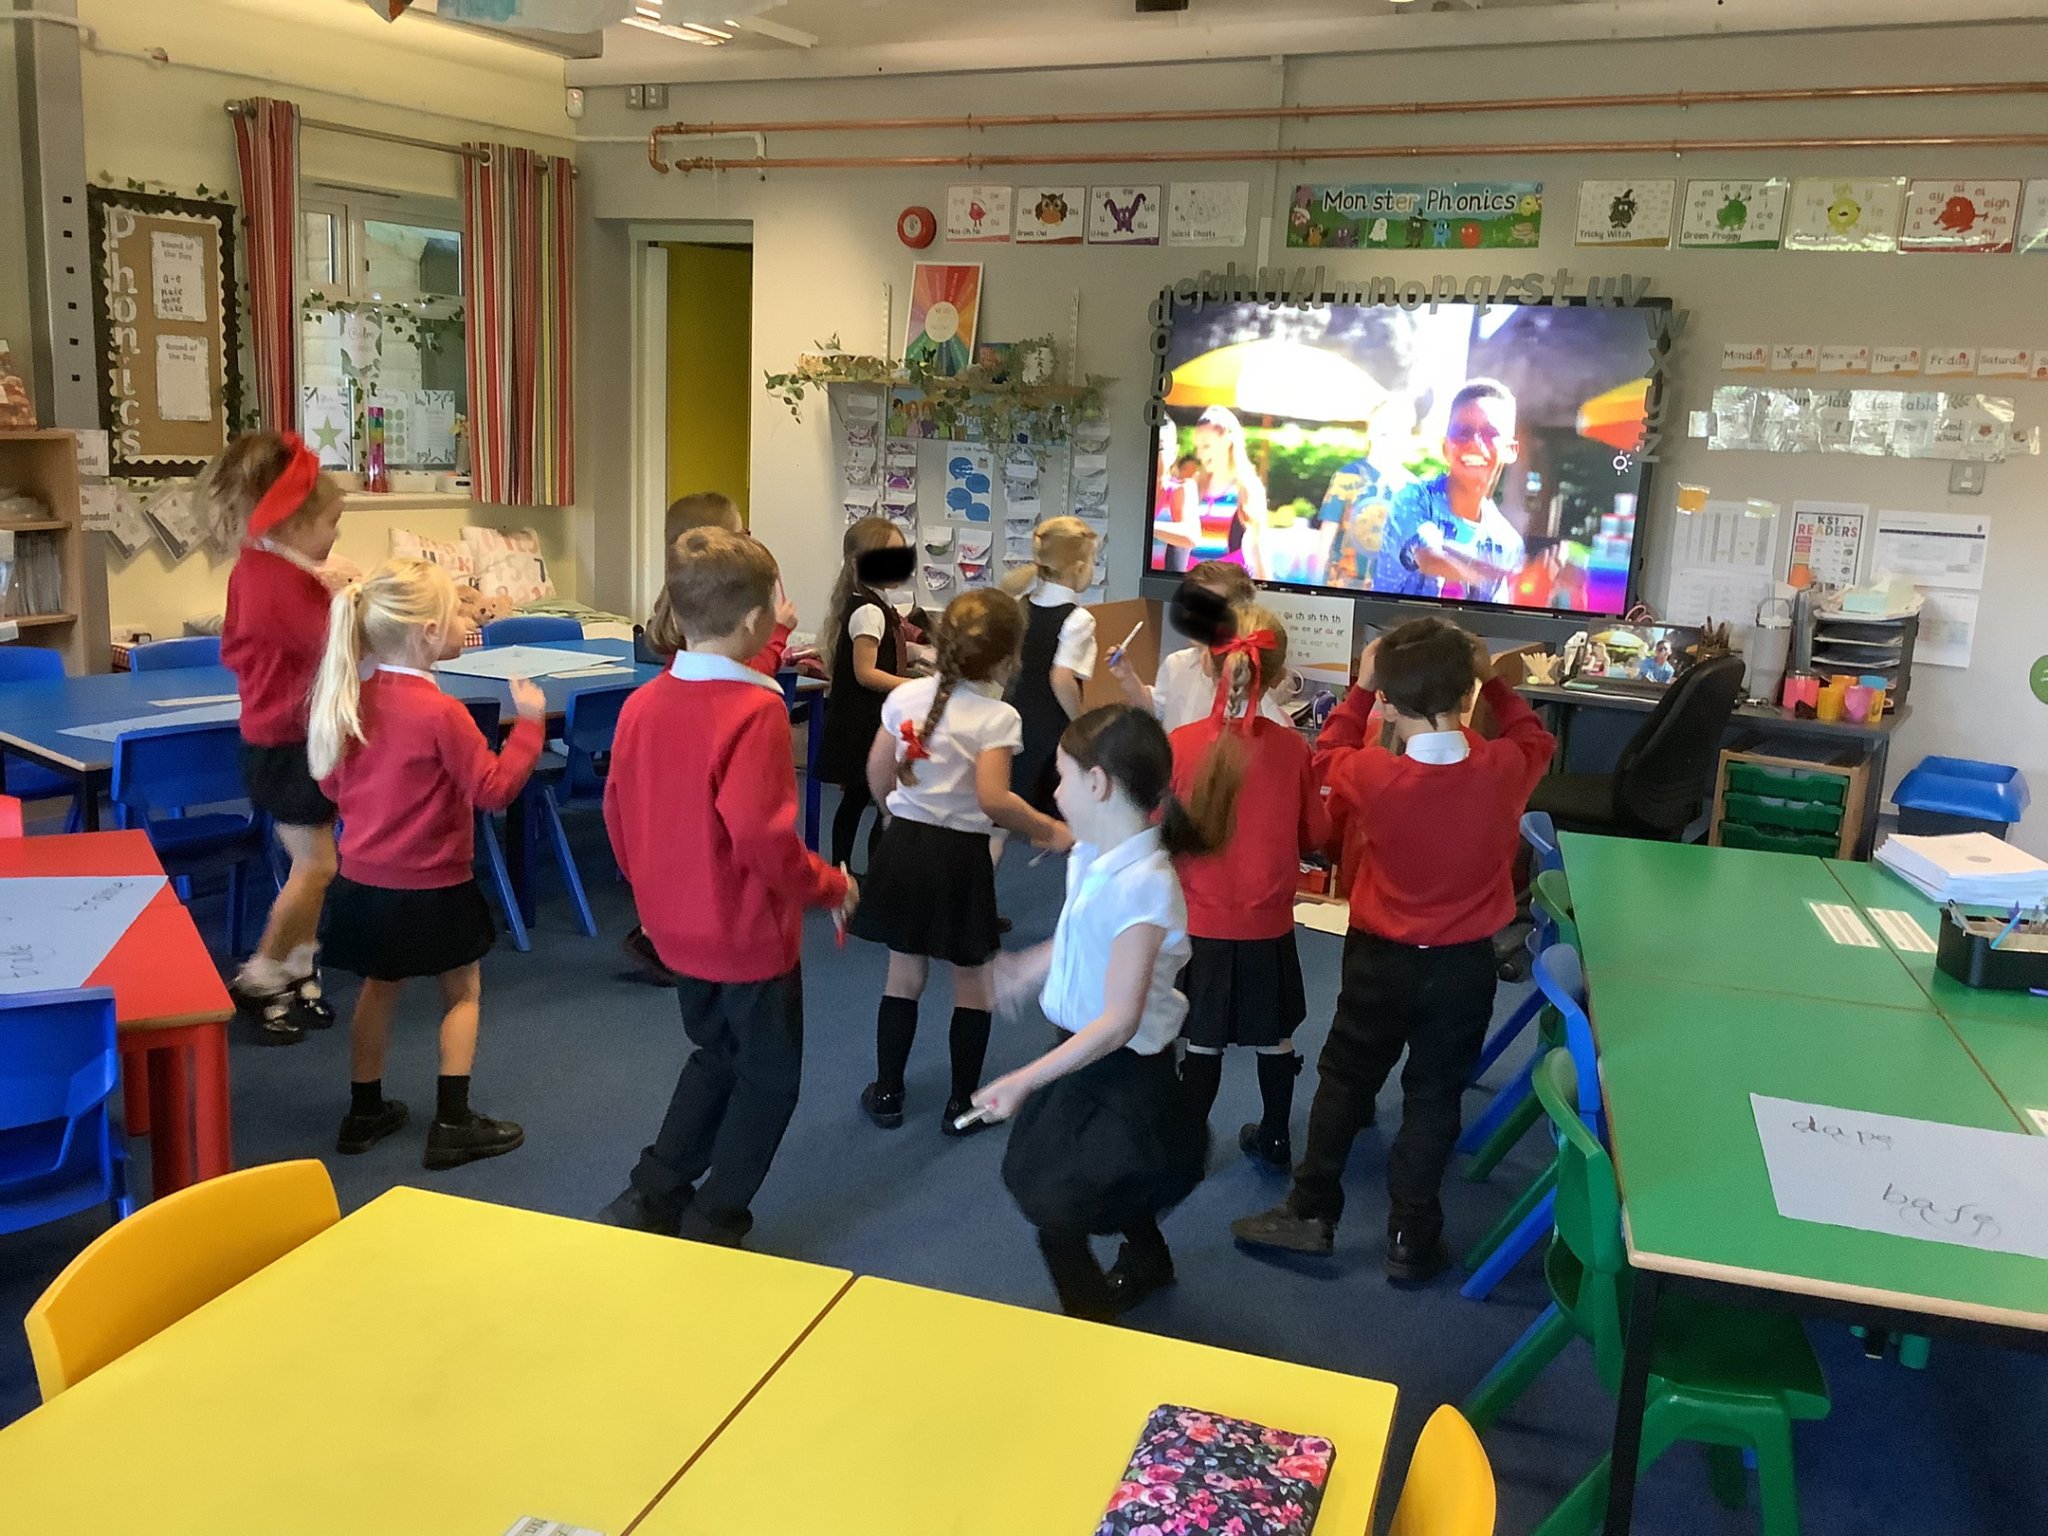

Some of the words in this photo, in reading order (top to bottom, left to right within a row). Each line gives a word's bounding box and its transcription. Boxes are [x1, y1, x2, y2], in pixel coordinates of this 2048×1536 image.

[1322, 188, 1420, 212] Monster
[1425, 188, 1518, 212] Phonics
[1579, 230, 1604, 240] Tricky
[1607, 229, 1632, 239] Witch
[1683, 231, 1709, 240] Green
[1711, 232, 1742, 242] Froggy
[110, 209, 142, 456] Phonics
[1930, 353, 1970, 368] Frday
[1980, 354, 2030, 367] Saturday
[81, 512, 110, 523] pendent
[1817, 515, 1840, 526] KS1
[1797, 523, 1858, 538] READERS
